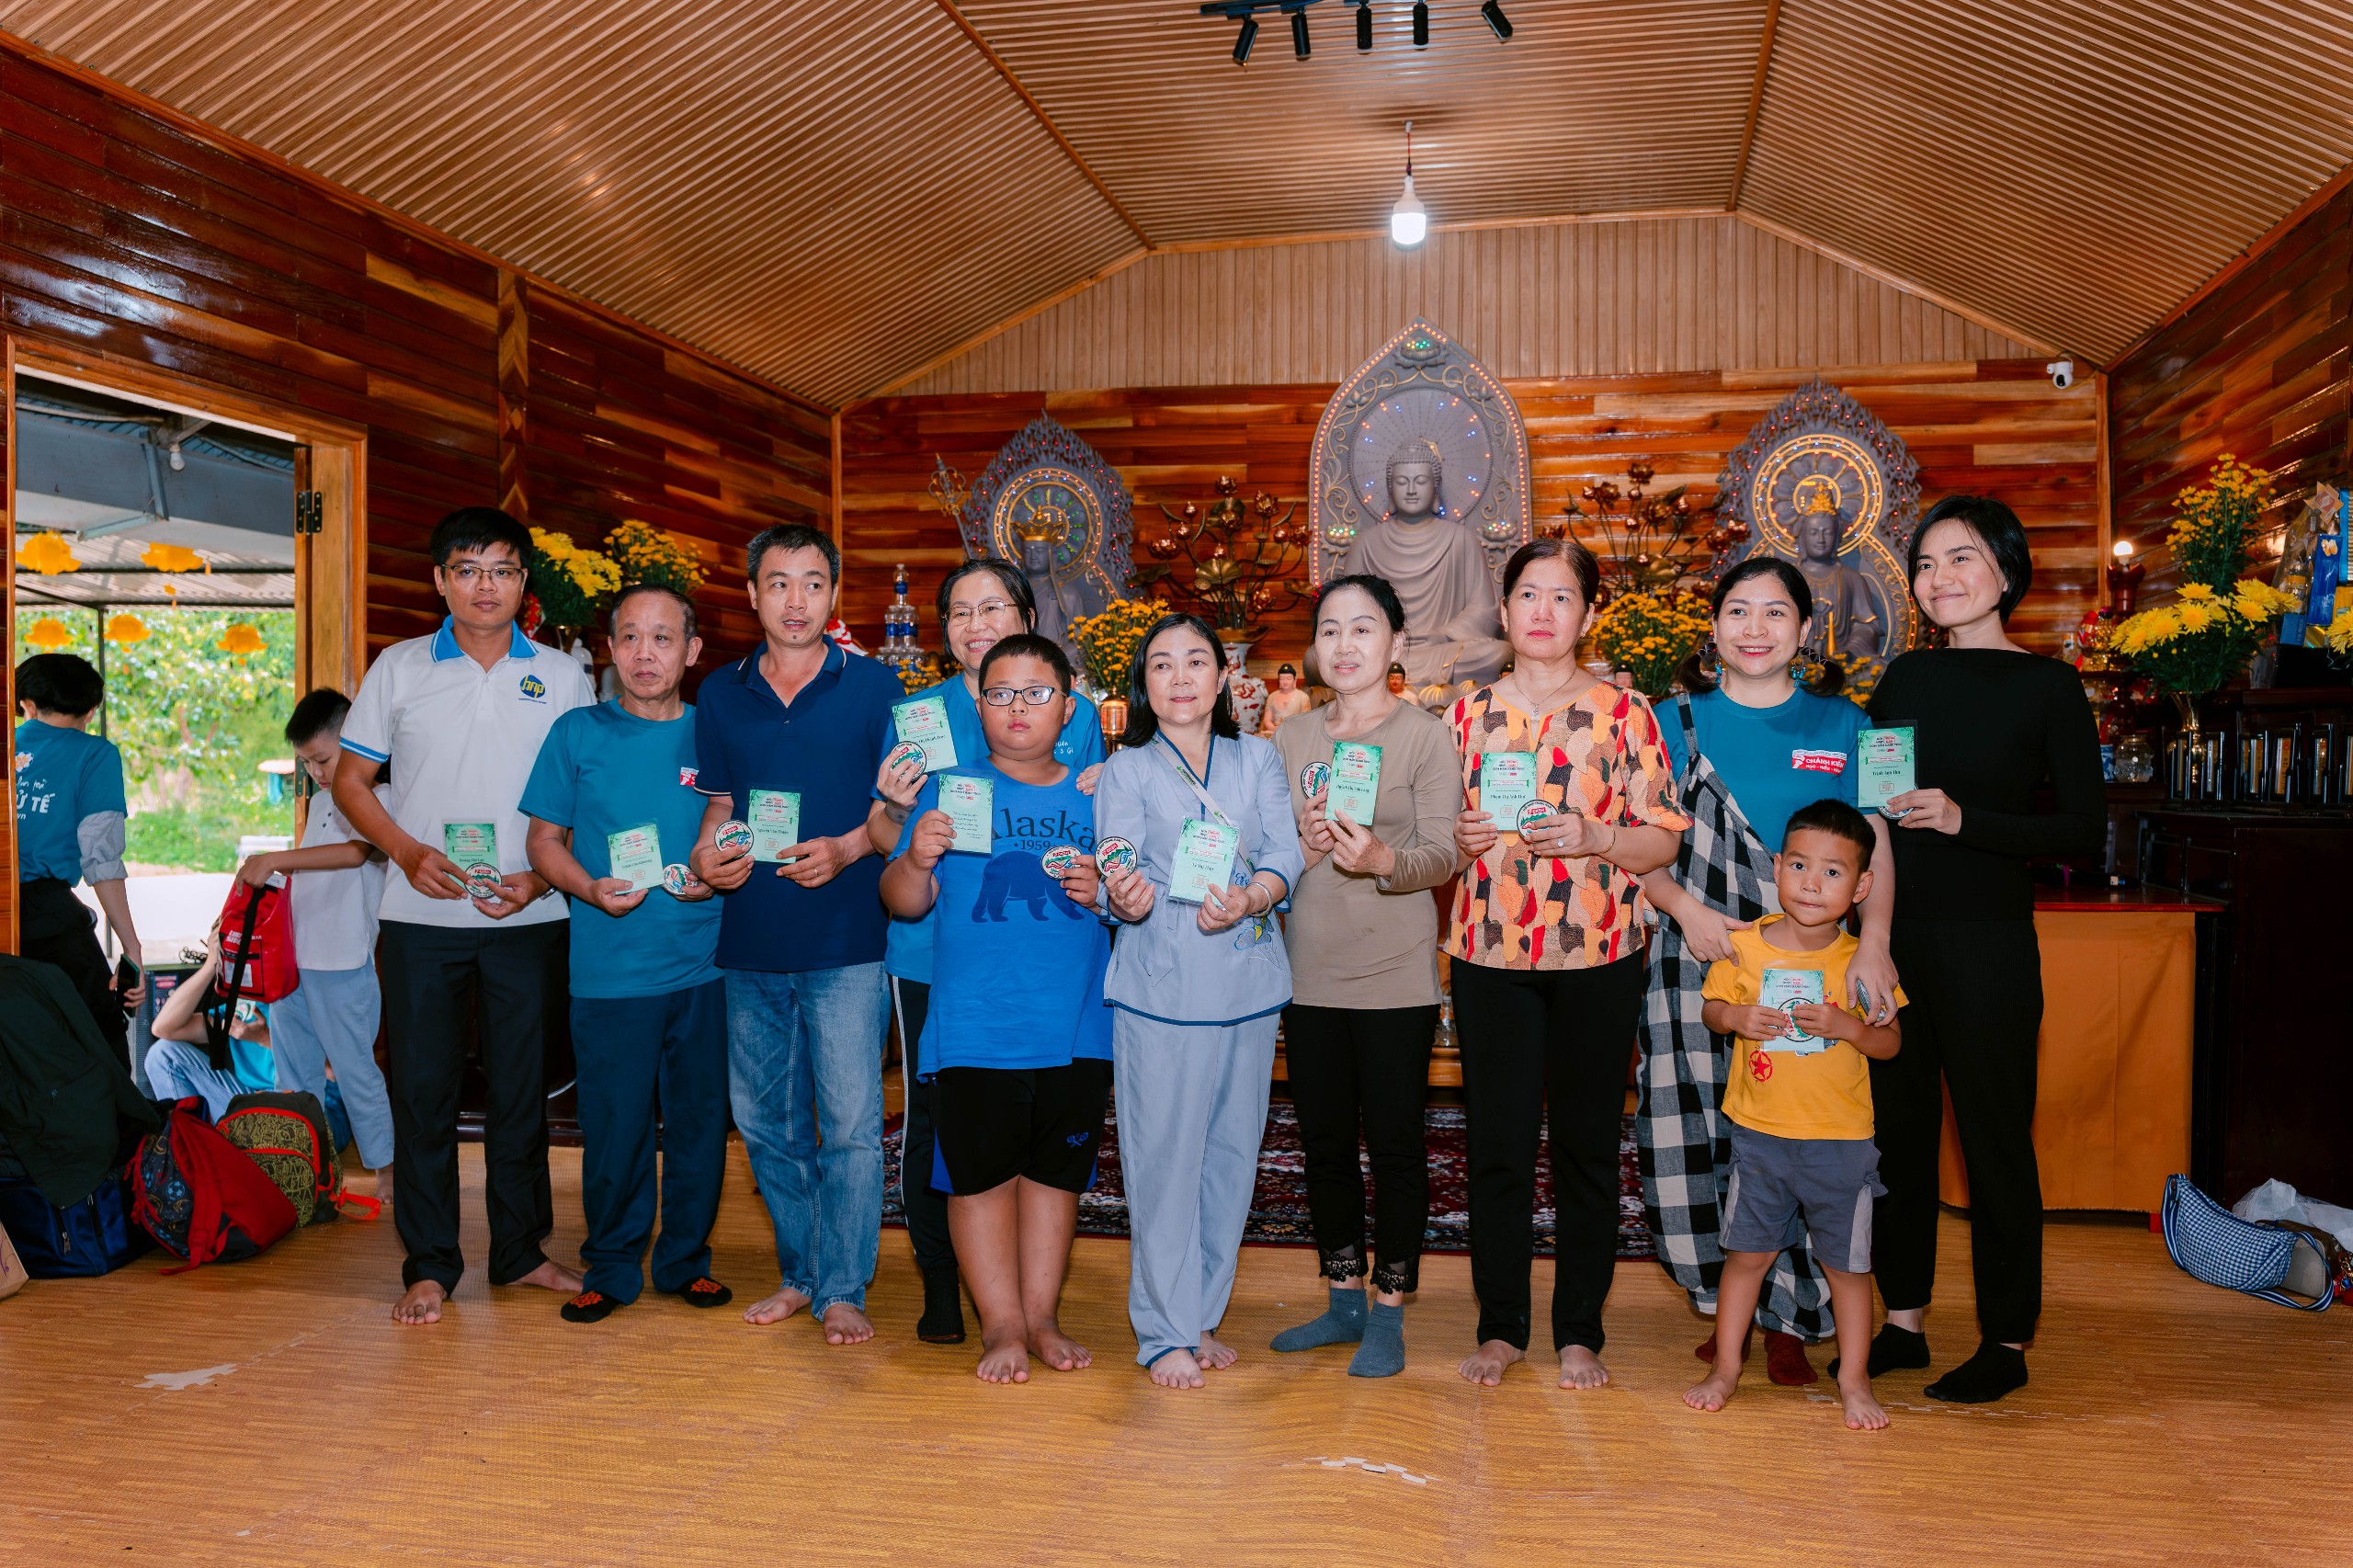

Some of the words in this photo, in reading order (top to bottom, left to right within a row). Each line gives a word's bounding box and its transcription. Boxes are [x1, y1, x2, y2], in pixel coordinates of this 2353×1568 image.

[1805, 757, 1830, 767] CHÁNH
[31, 792, 56, 814] TẾ
[1020, 839, 1051, 851] 1959
